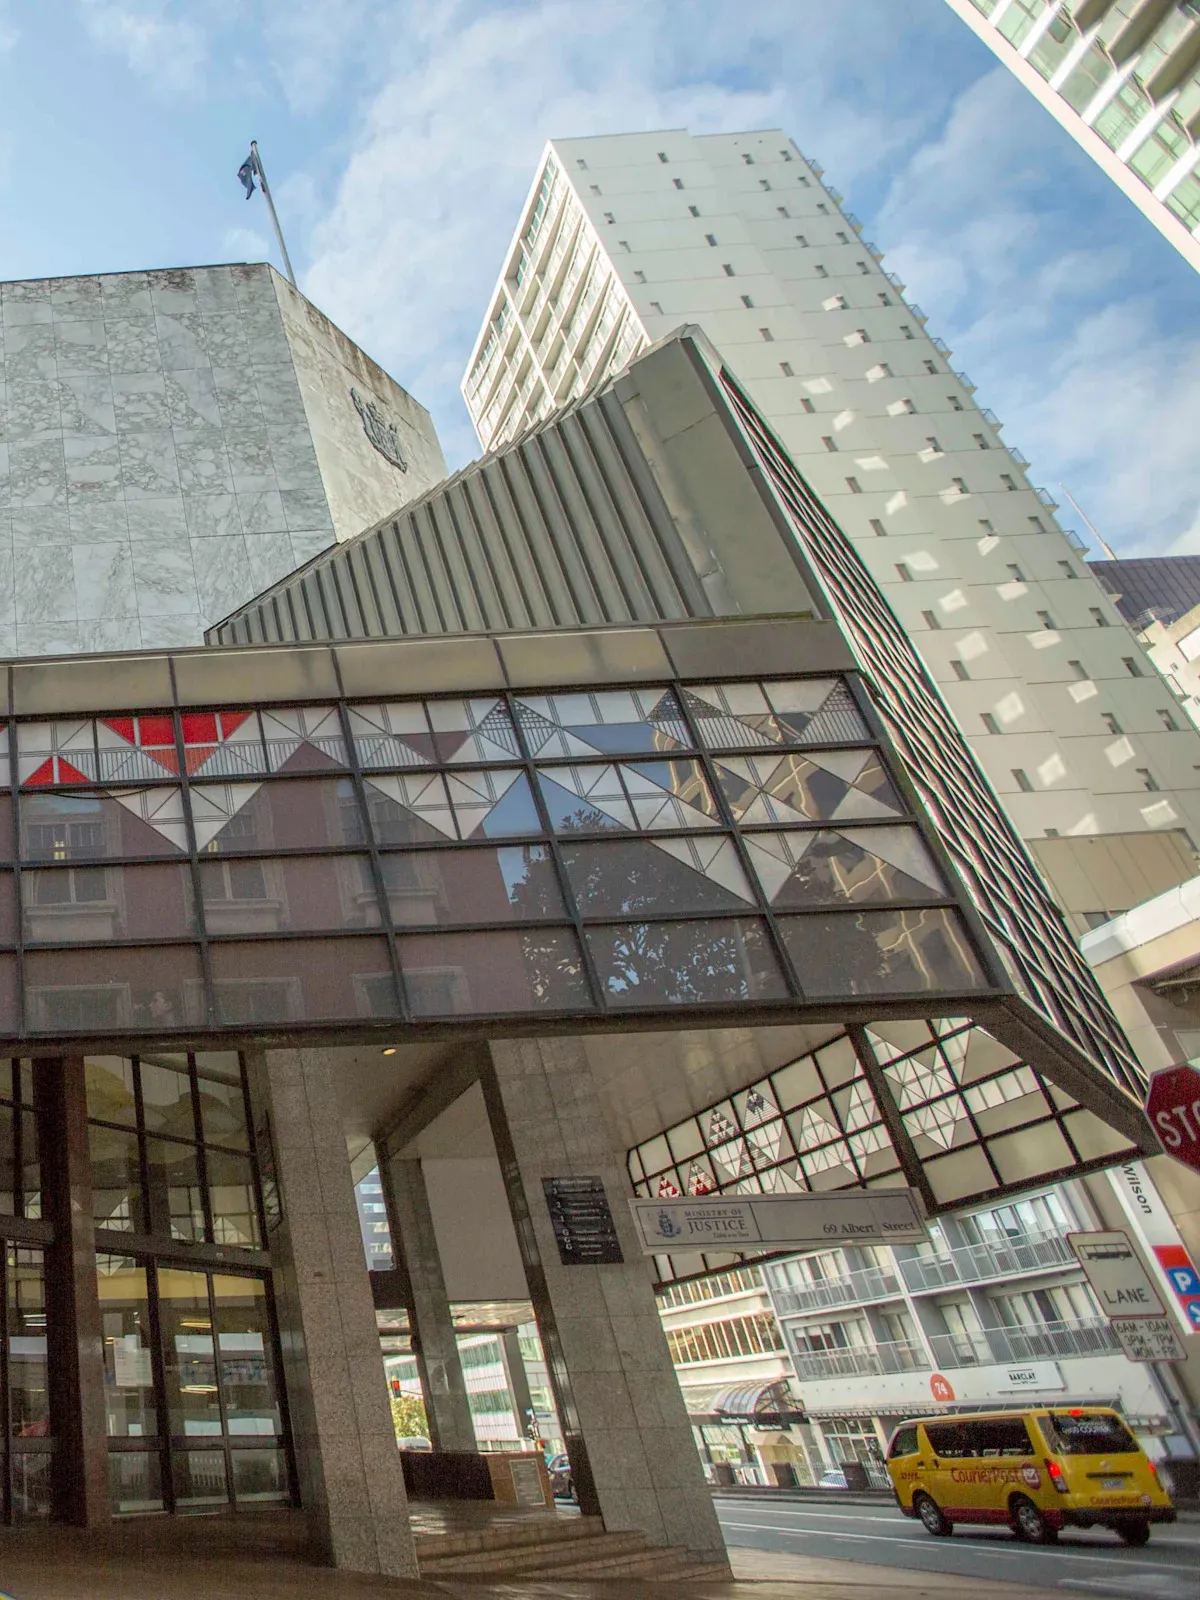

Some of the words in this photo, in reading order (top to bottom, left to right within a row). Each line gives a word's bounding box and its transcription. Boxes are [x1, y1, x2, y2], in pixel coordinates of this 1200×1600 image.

[1156, 1102, 1200, 1147] ST
[1121, 1163, 1153, 1214] Wilson
[684, 1208, 728, 1218] MINISTRY
[731, 1208, 742, 1216] OF
[686, 1219, 748, 1234] JUSTICE
[823, 1223, 838, 1234] 69
[840, 1222, 876, 1234] Albert
[882, 1221, 917, 1232] Street
[1103, 1287, 1150, 1304] LANE
[1009, 1372, 1036, 1381] BARCLAY
[934, 1382, 948, 1395] 74
[951, 1465, 1021, 1484] CourierPost
